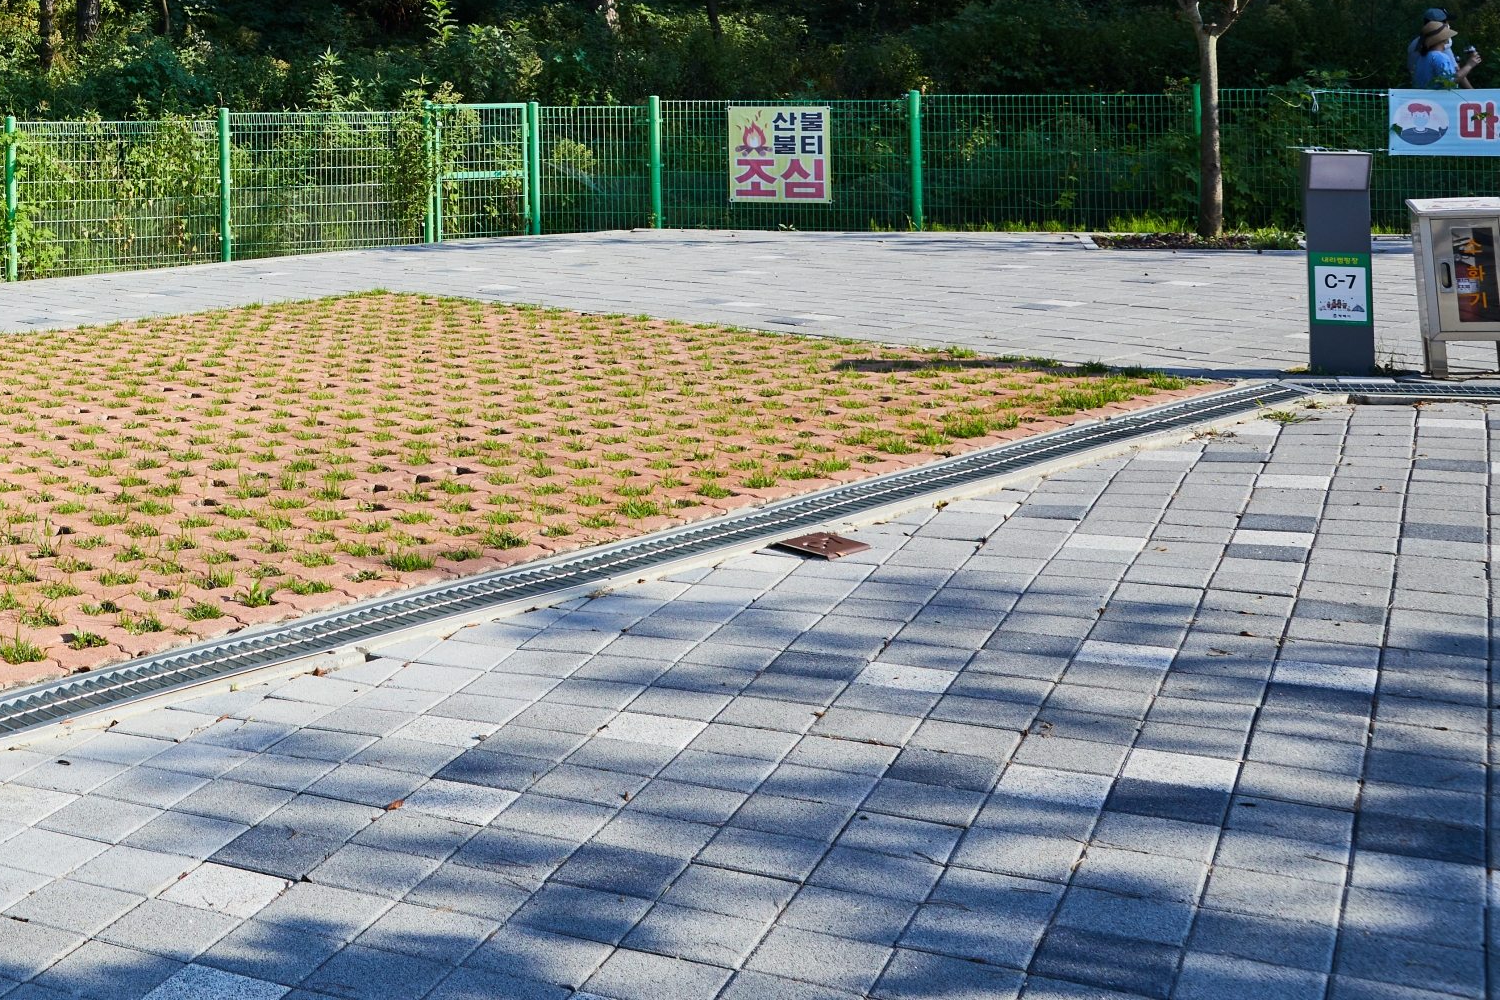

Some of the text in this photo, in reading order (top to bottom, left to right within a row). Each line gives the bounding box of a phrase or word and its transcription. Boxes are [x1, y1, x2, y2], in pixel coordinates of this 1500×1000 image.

[772, 112, 823, 132] 산불
[1460, 102, 1500, 139] 마
[773, 135, 823, 155] 불티
[735, 159, 825, 199] 조심
[1324, 273, 1357, 290] C-7
[1462, 239, 1487, 309] 소화기
